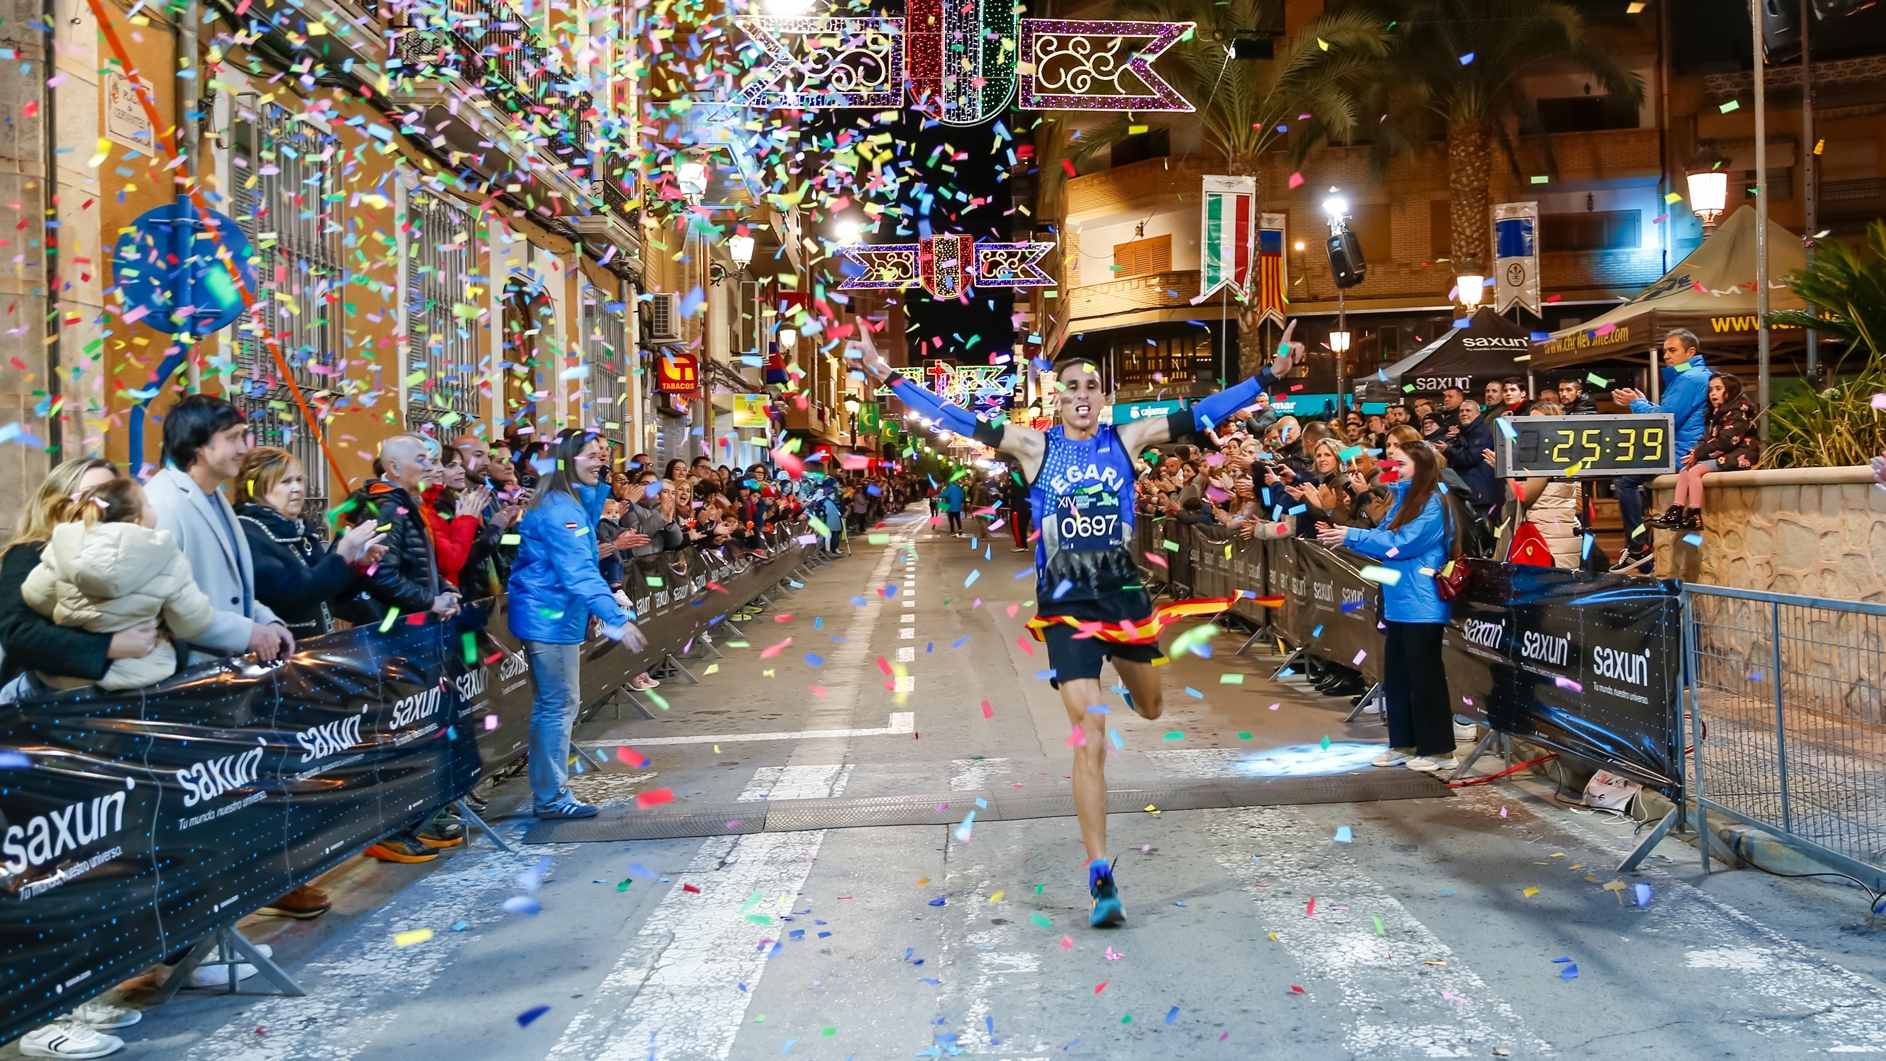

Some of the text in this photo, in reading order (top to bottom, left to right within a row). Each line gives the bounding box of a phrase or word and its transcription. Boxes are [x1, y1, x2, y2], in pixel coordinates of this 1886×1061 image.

[1462, 337, 1529, 347] saxun
[662, 382, 695, 390] TABACOS
[1416, 376, 1471, 390] saxun
[1140, 406, 1170, 417] cajamar
[1050, 463, 1125, 496] EGARI
[1057, 495, 1076, 508] XIV
[1061, 514, 1118, 538] 0697
[1313, 580, 1334, 602] saxun
[1461, 618, 1505, 649] saxun
[1521, 631, 1571, 666] saxun
[1593, 646, 1650, 686] saxun
[456, 665, 489, 703] saxun
[389, 677, 444, 730] saxun
[296, 704, 368, 763] saxun
[176, 737, 267, 807] saxun
[3, 778, 135, 875] saxun
[179, 817, 189, 831] Tu
[189, 809, 216, 827] mundo,
[216, 800, 242, 818] nuestro
[63, 861, 90, 882] nuestro
[89, 846, 123, 868] universo.
